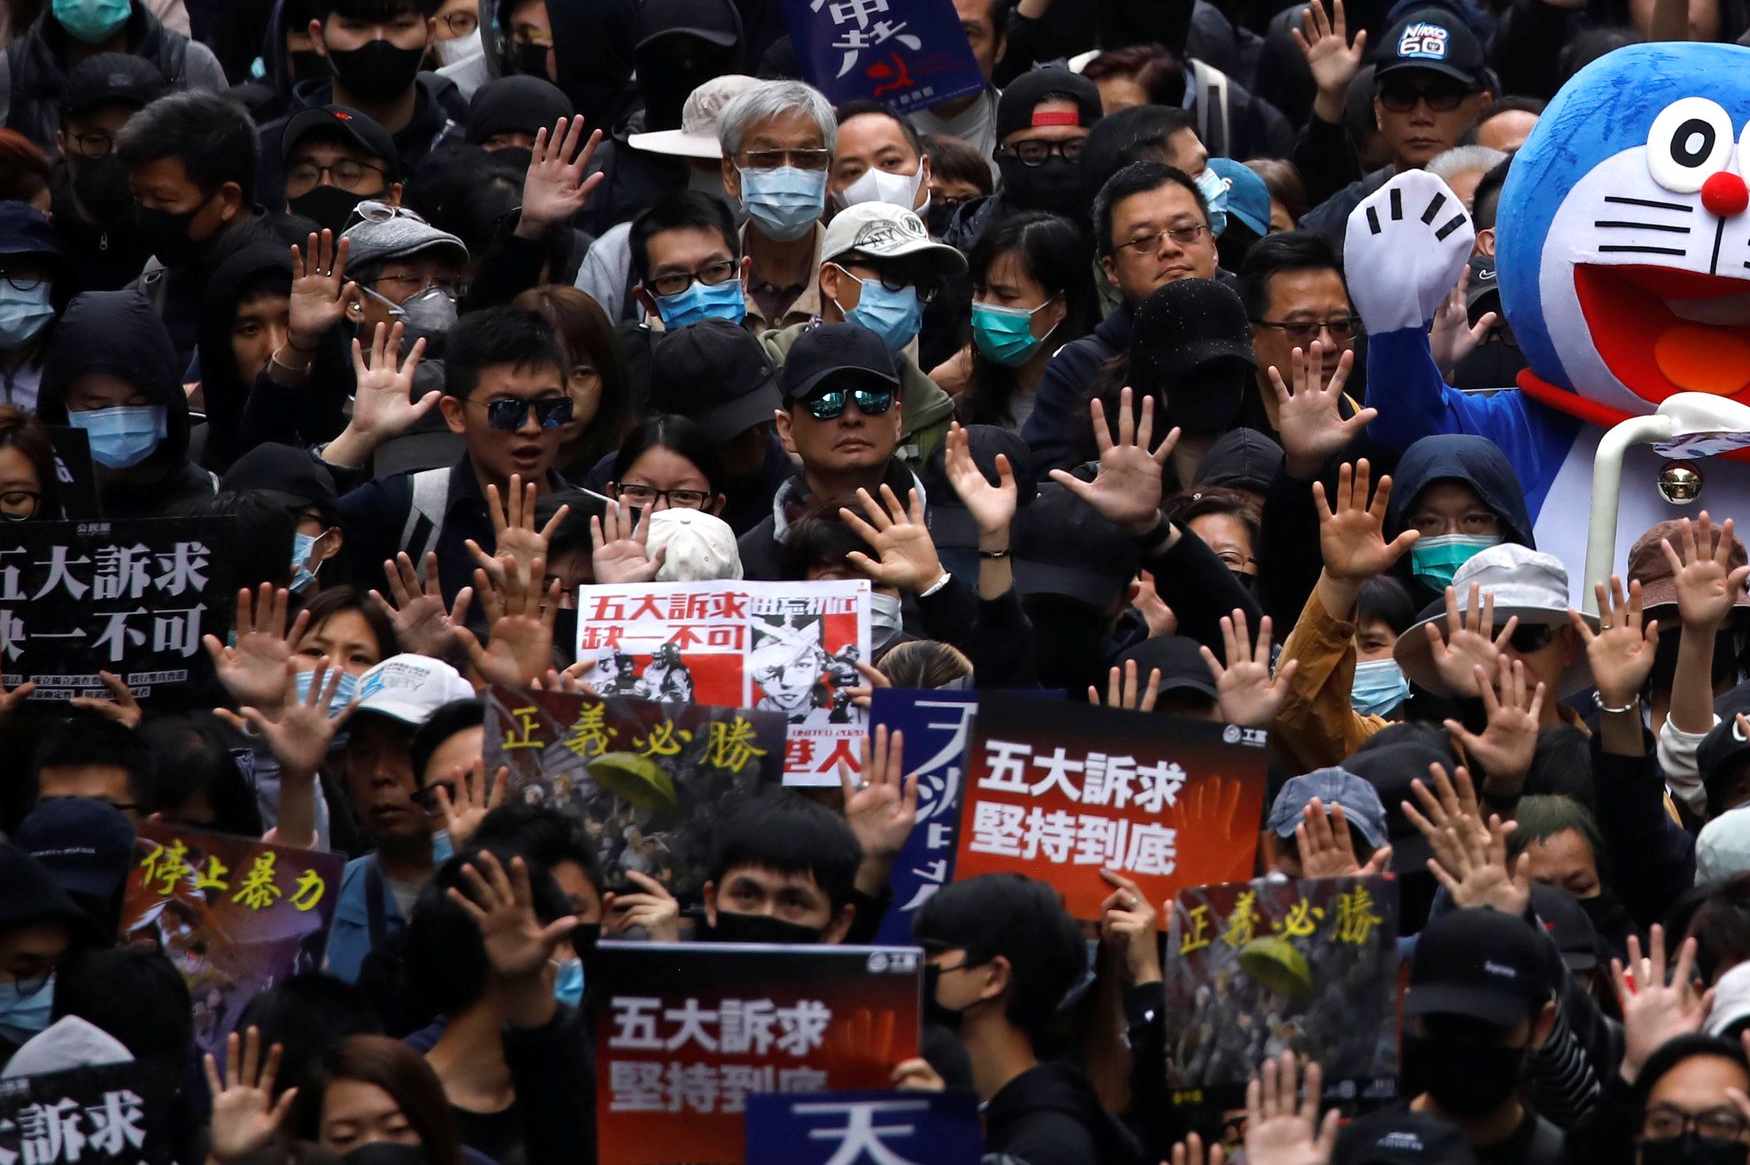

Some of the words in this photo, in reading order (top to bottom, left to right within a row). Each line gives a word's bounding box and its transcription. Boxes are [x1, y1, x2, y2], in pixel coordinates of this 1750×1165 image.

[582, 623, 745, 651] 缺一不可
[585, 592, 751, 621] 五大訴求
[502, 701, 768, 773] 正義必勝
[976, 739, 1187, 814] 五大訴求
[968, 799, 1178, 877] 堅持到底
[139, 838, 326, 912] 停止暴力
[1180, 887, 1384, 955] 正義必勝
[608, 995, 833, 1056] 五大訴求
[0, 1087, 148, 1165] 訴求
